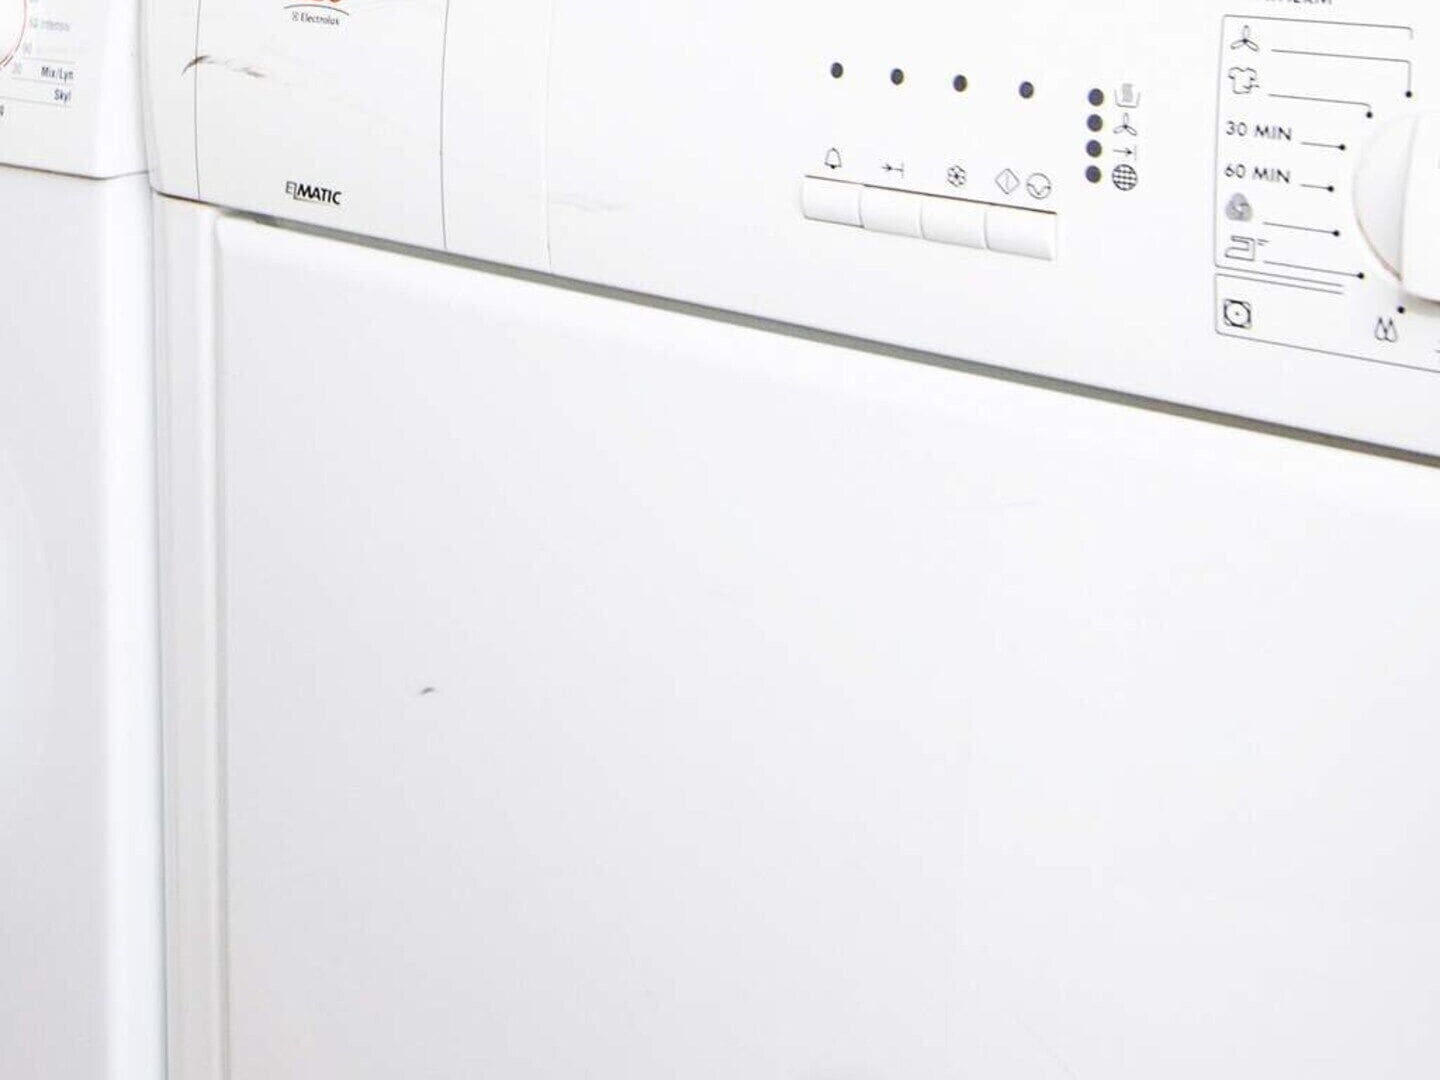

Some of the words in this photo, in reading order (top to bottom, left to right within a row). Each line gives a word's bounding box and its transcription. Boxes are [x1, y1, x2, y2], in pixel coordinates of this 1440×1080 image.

[300, 12, 340, 26] Electrolux
[54, 88, 72, 103] Skyl
[1225, 120, 1248, 138] 30
[1254, 124, 1292, 142] MIN
[1224, 164, 1247, 180] 60
[1252, 166, 1292, 185] MIN
